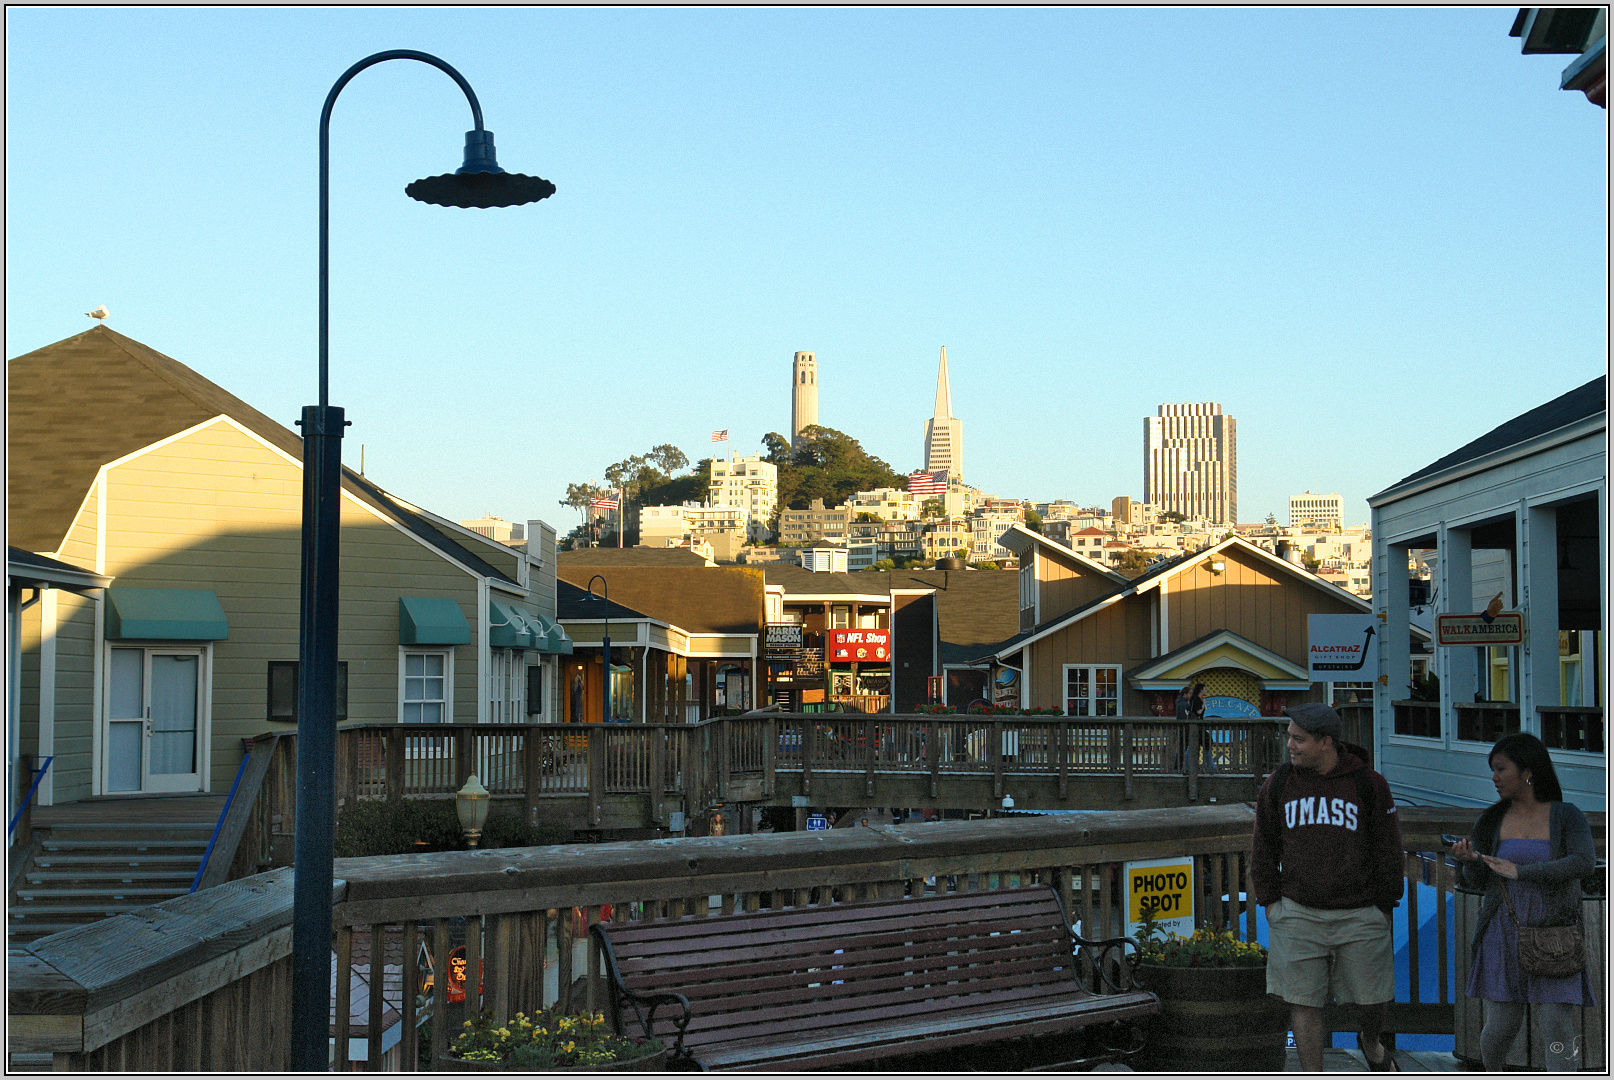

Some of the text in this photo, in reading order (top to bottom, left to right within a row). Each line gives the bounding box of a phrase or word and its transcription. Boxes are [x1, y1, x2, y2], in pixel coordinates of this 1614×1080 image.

[768, 626, 800, 635] HARRY
[1442, 624, 1518, 635] WALKAMERICA
[847, 633, 863, 643] NFL
[866, 633, 887, 645] Shop
[1205, 699, 1225, 710] EPE
[1285, 797, 1358, 831] UMASS
[1134, 872, 1187, 893] PHOTO
[1140, 894, 1182, 912] SPOT
[1172, 920, 1181, 928] by
